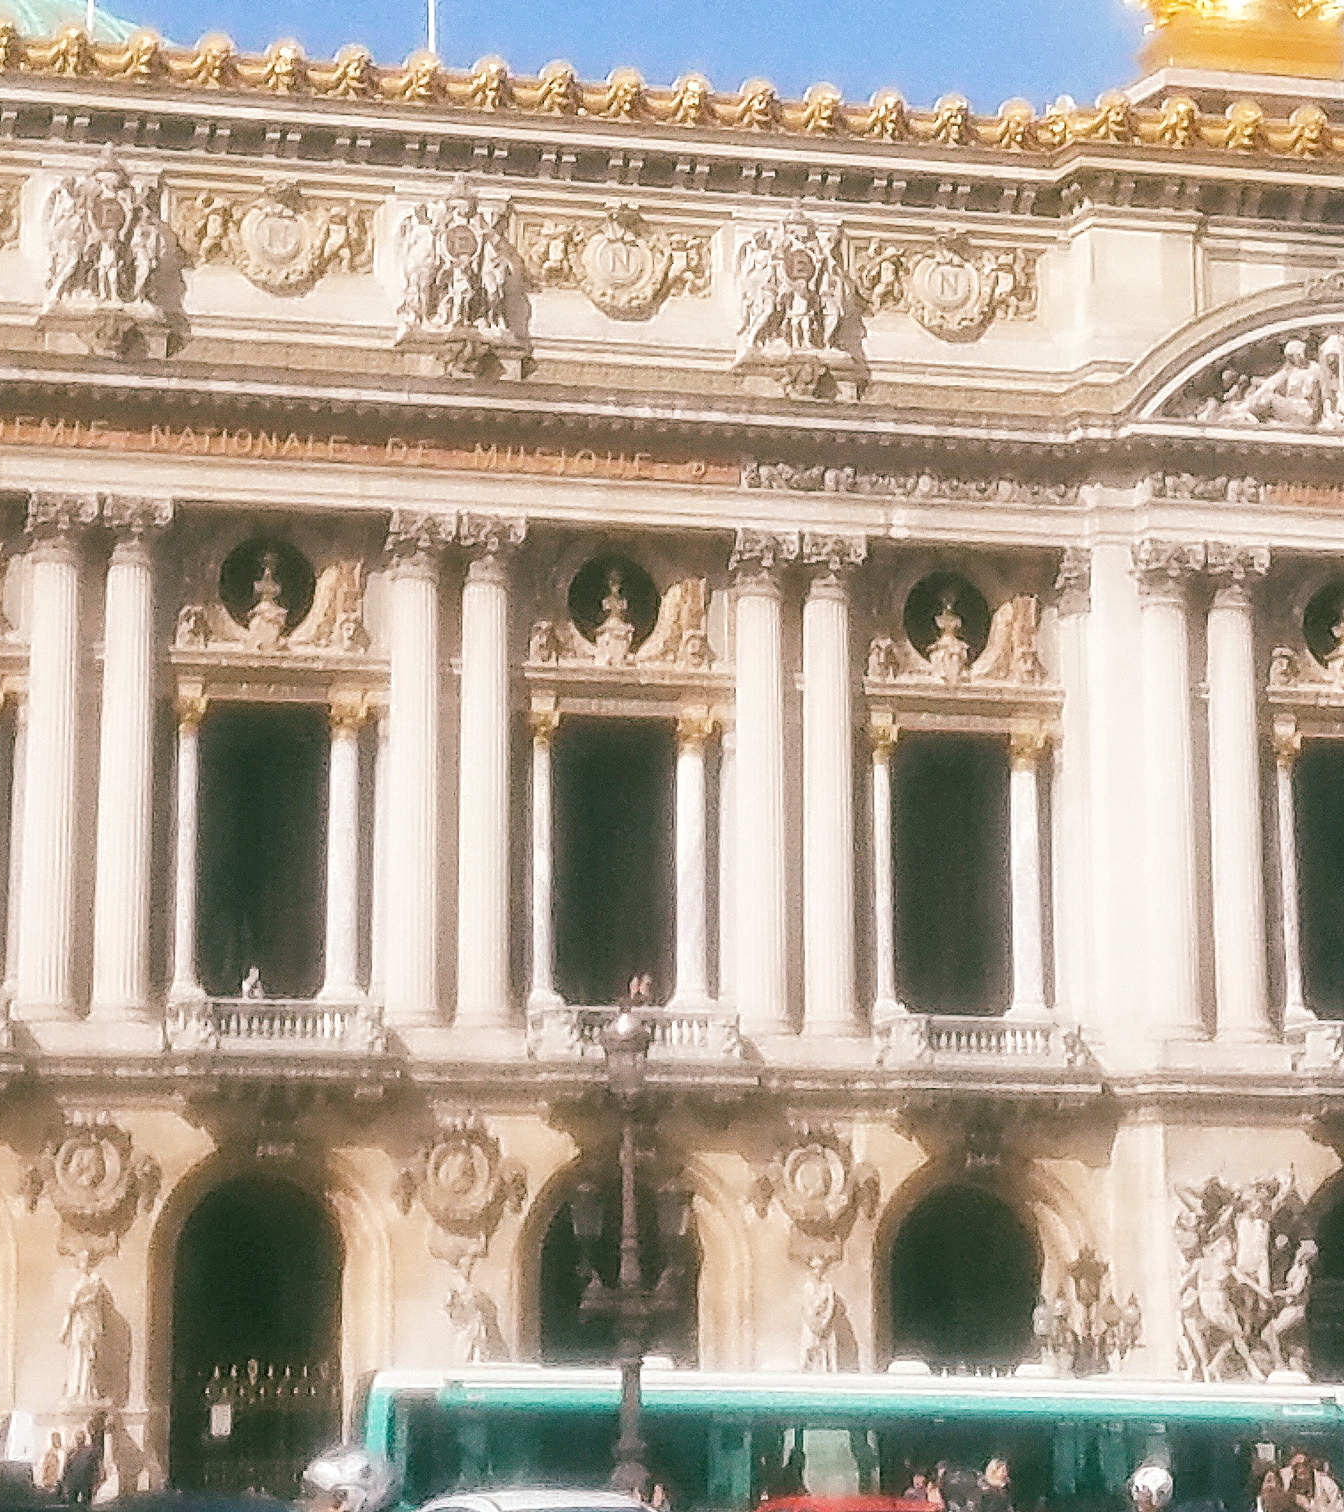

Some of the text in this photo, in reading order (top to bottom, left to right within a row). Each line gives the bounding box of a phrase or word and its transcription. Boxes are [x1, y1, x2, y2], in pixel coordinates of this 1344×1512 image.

[609, 245, 632, 274] N
[941, 271, 959, 296] N
[150, 424, 349, 461] NATIONALE
